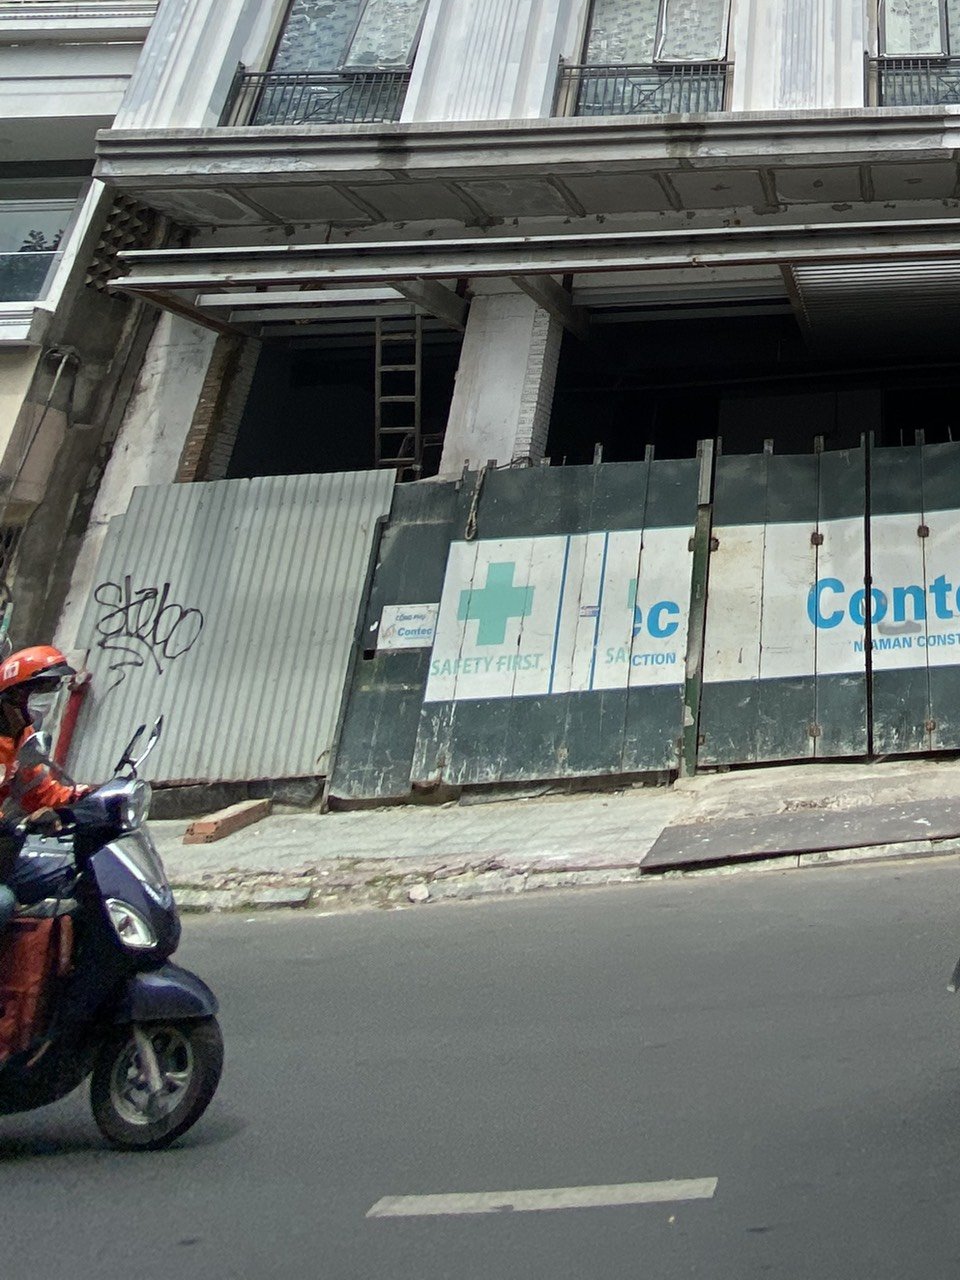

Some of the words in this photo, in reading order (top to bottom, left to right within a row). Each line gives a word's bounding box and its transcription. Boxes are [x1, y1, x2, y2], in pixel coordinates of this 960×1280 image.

[397, 627, 433, 637] Contec
[430, 656, 493, 676] SAFETY
[495, 653, 544, 672] FIRST
